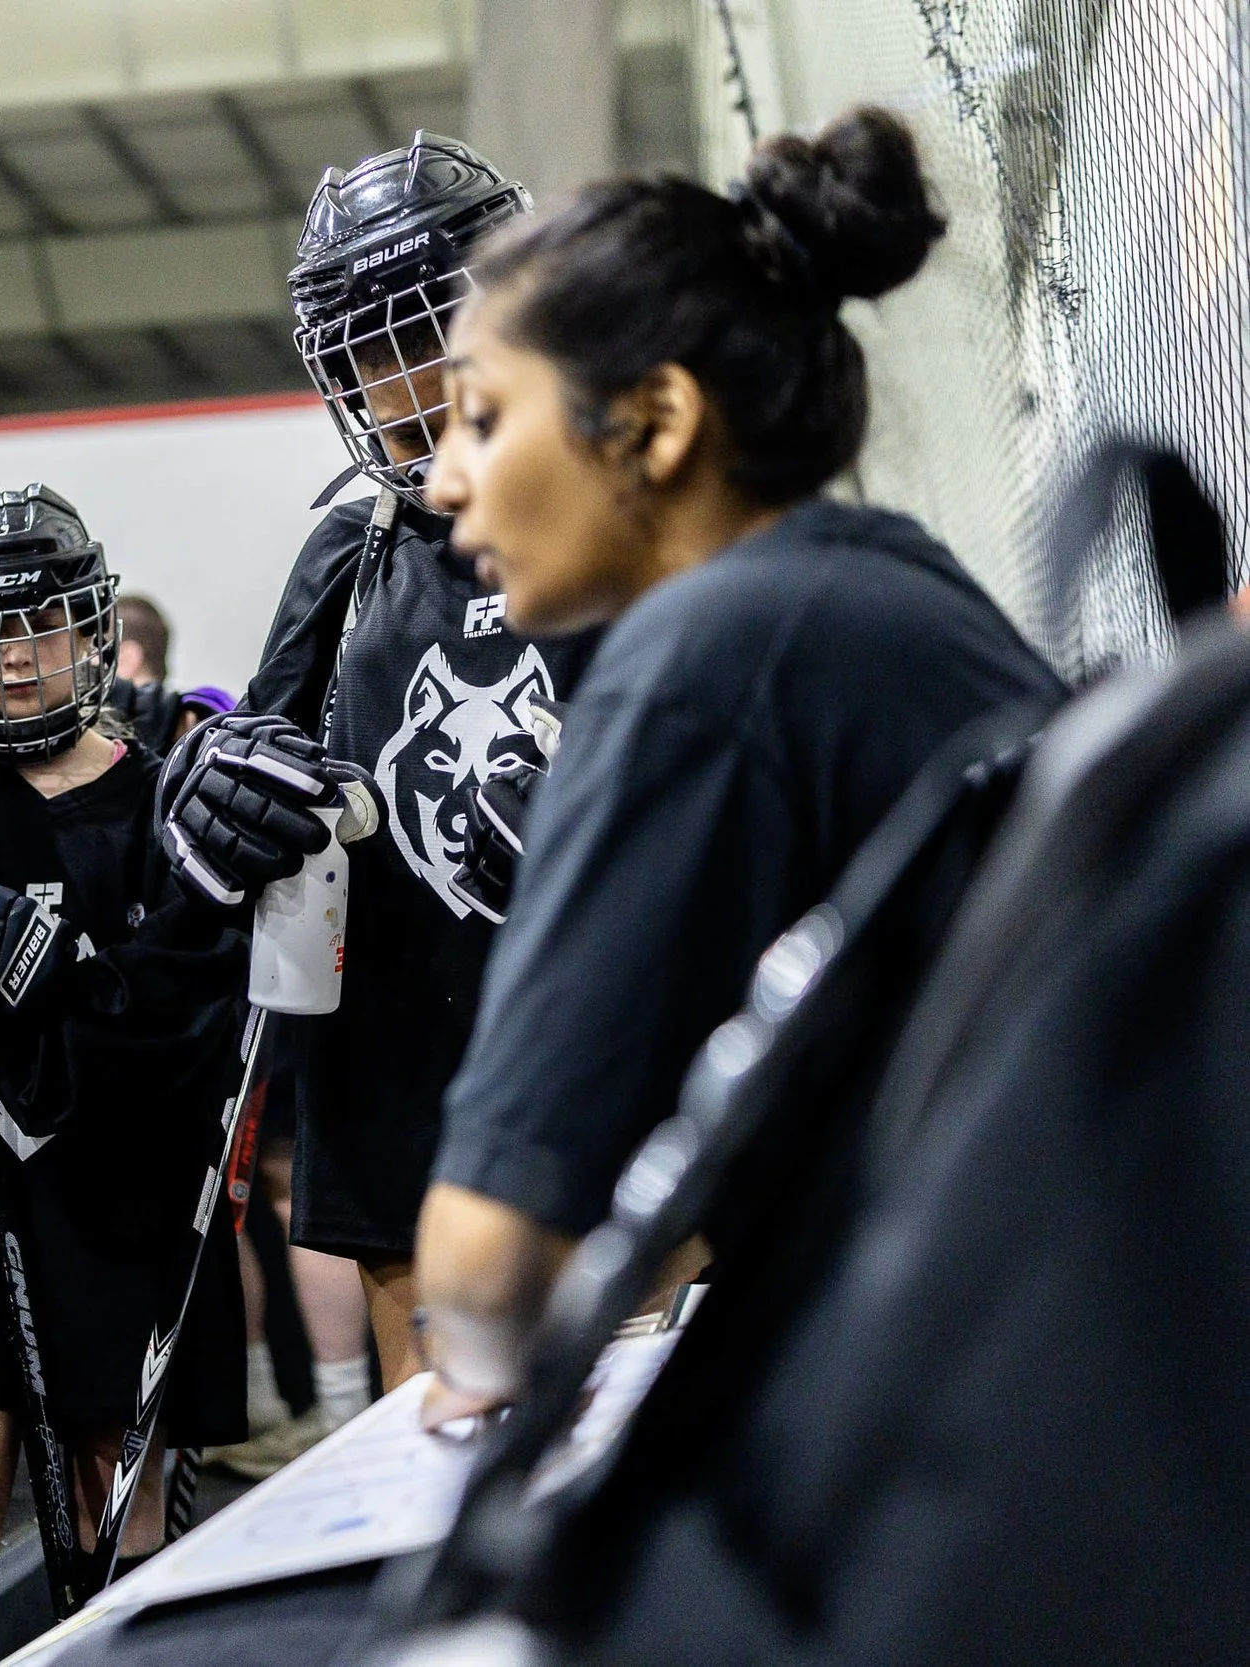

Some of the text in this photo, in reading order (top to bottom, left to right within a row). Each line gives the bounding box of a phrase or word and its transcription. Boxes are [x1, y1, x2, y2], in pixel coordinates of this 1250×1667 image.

[352, 231, 430, 275] BAUER
[463, 626, 503, 639] FREEPLAY
[8, 923, 48, 991] BAUER
